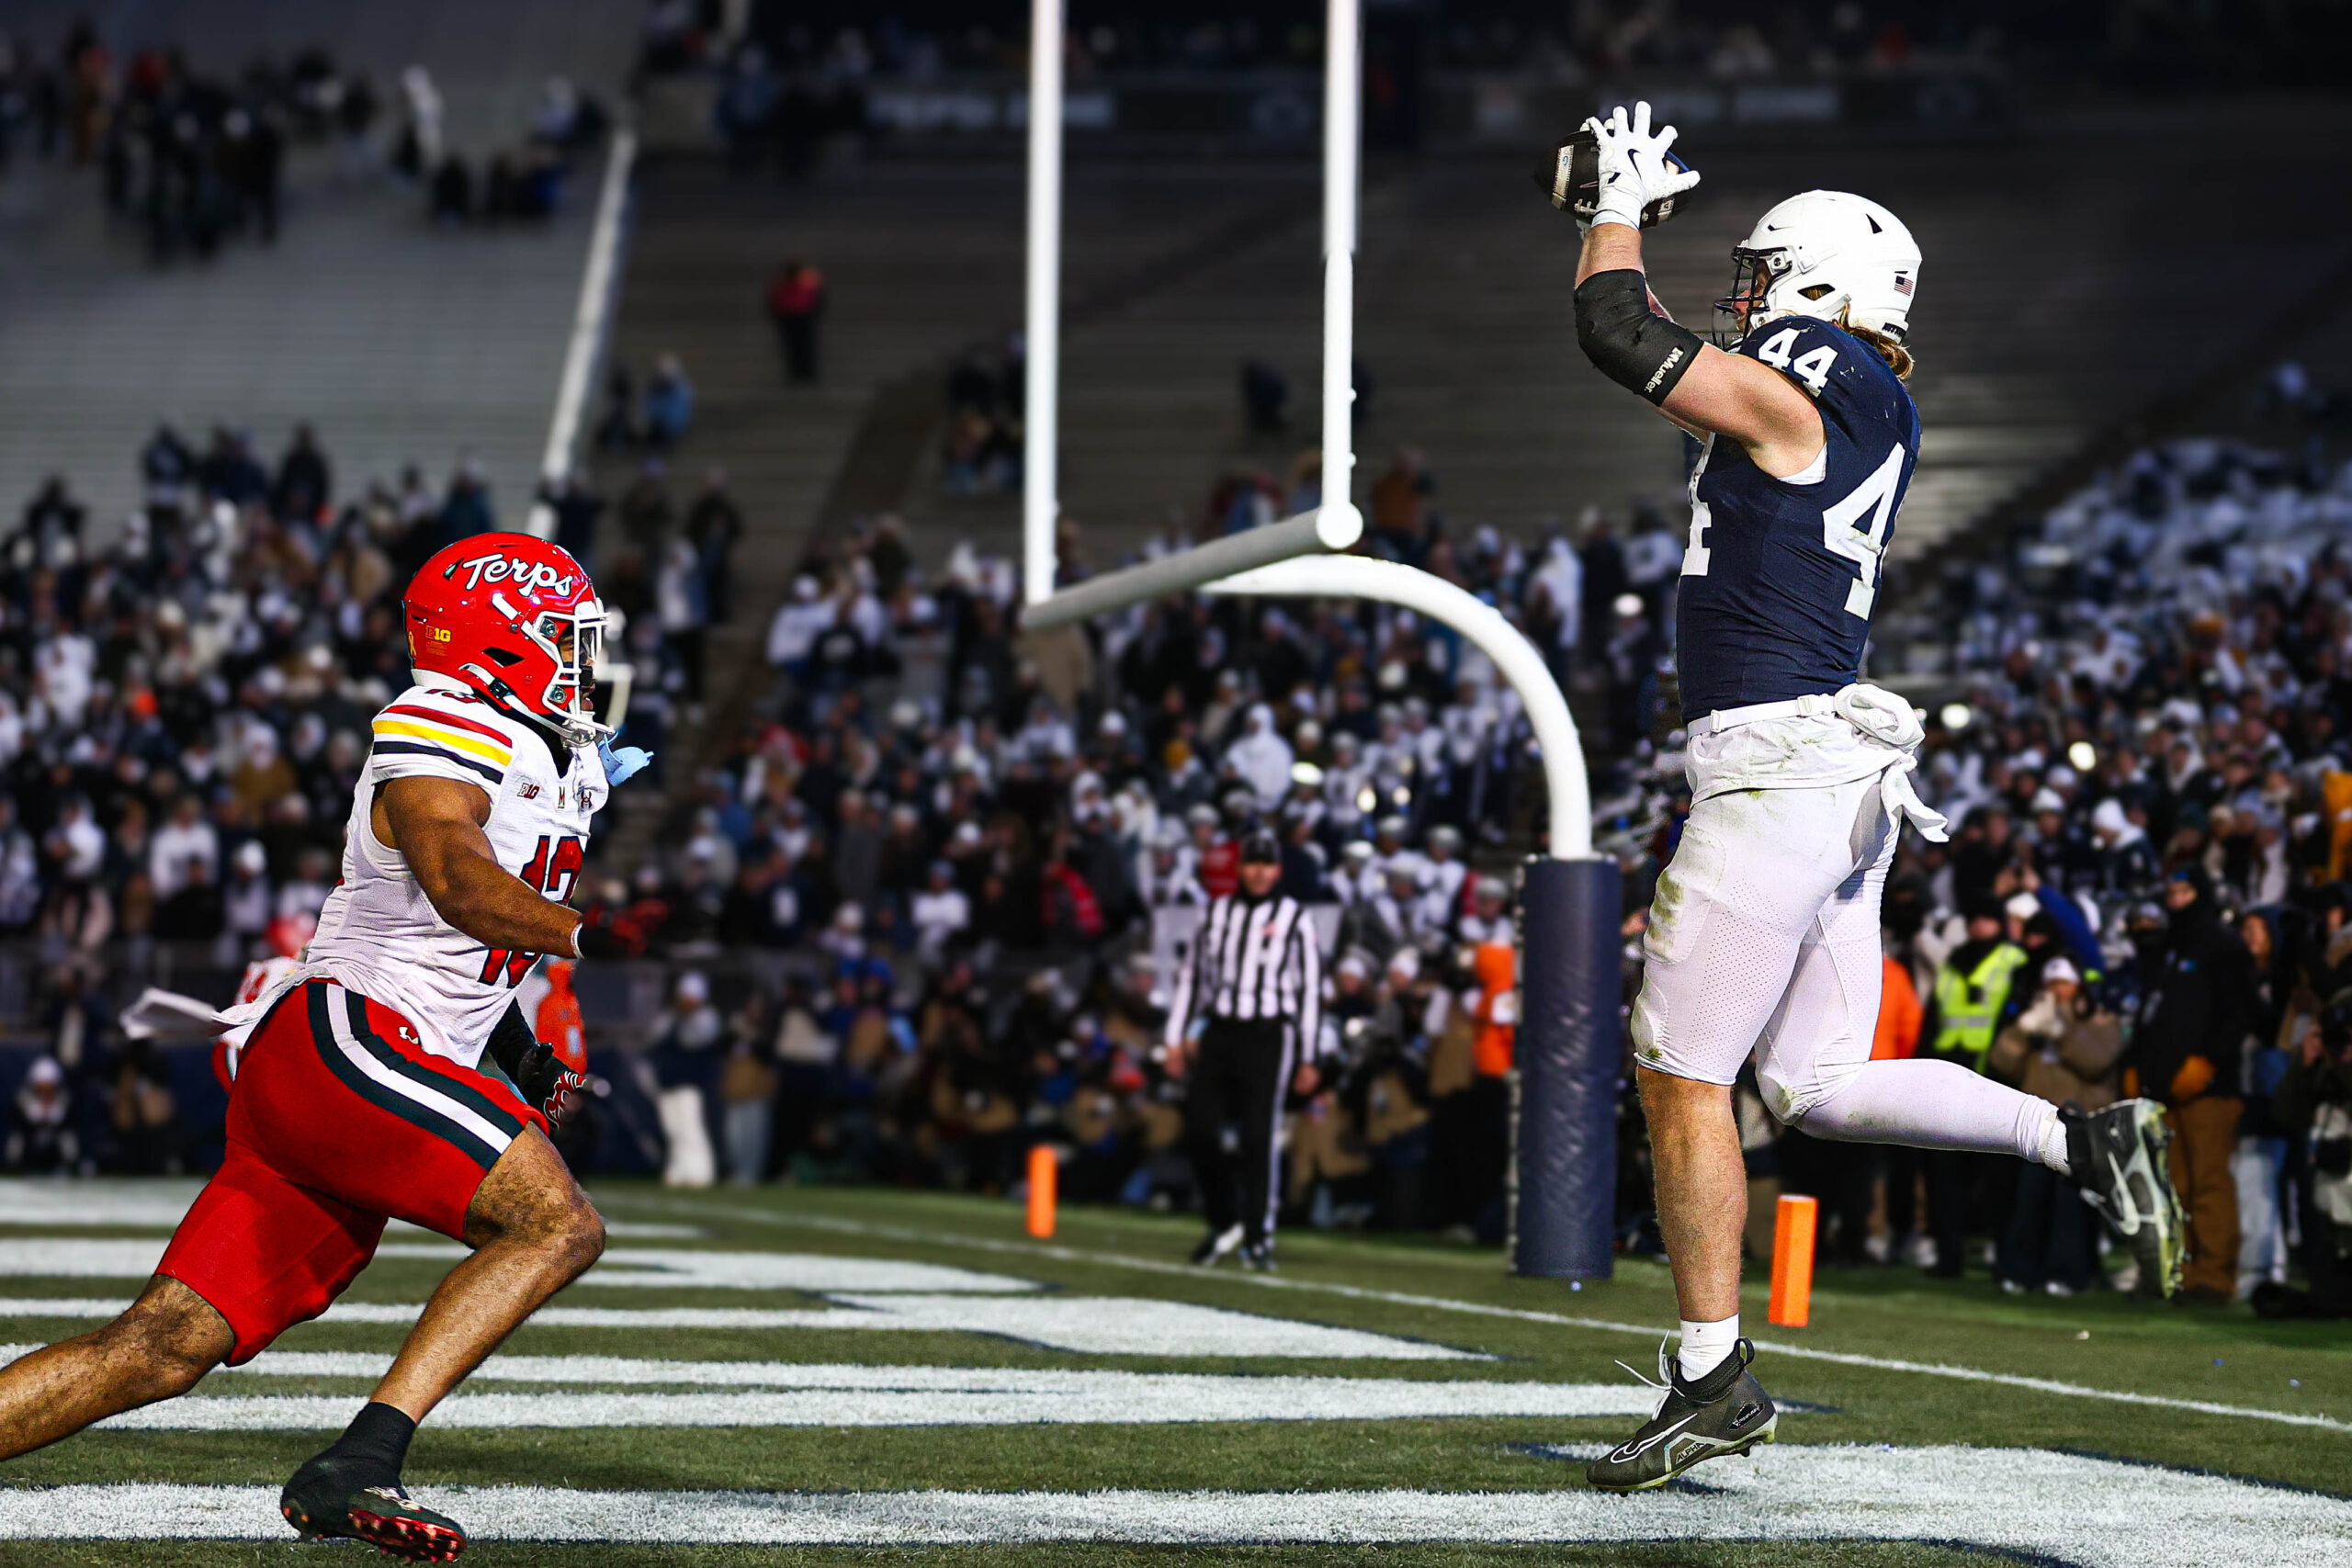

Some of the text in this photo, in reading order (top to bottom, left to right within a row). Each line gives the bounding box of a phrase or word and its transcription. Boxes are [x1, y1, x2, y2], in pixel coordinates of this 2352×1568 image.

[1757, 328, 1838, 397] 44
[462, 553, 573, 597] Terps
[1677, 1443, 1705, 1463] ALPHA
